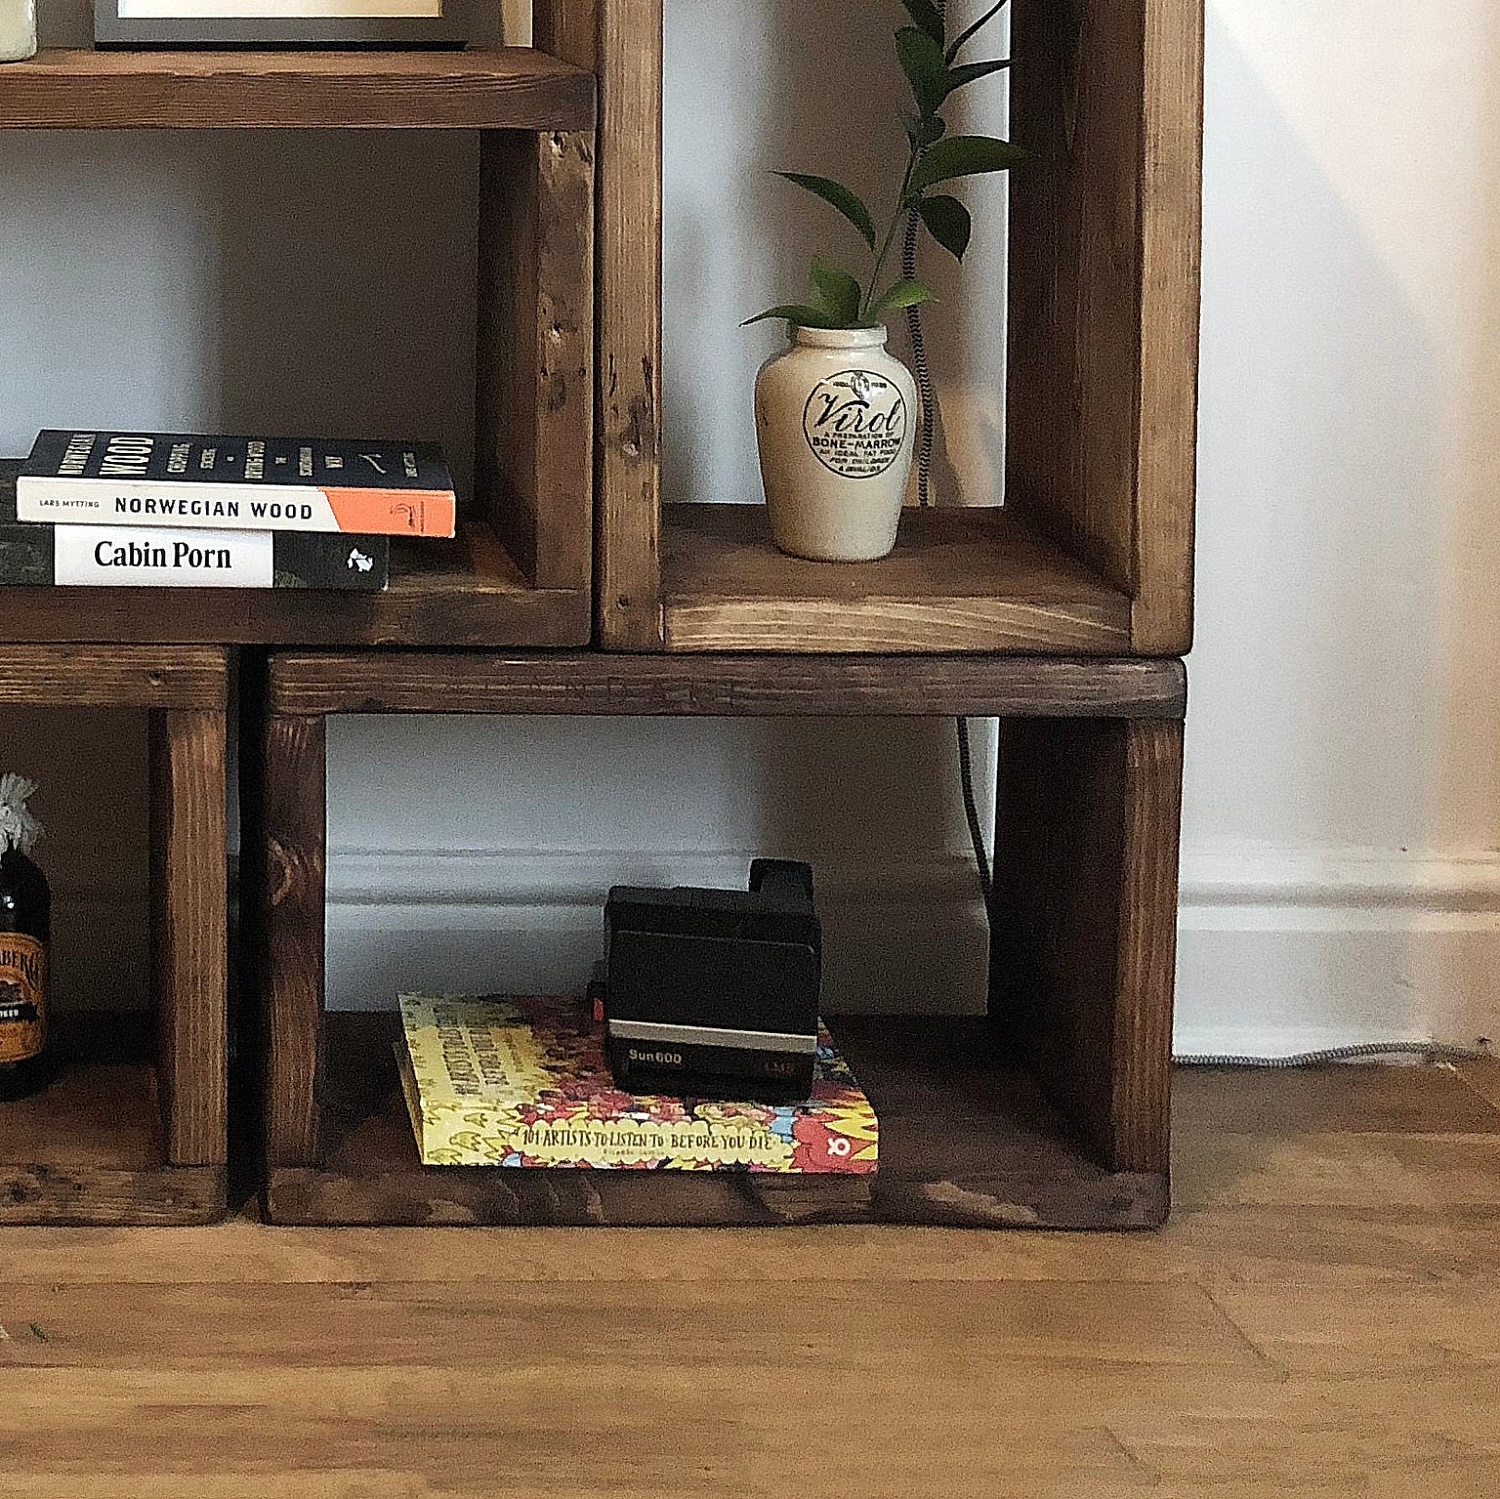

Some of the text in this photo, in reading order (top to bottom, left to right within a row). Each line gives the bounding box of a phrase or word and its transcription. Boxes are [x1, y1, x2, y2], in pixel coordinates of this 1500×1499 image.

[814, 393, 901, 432] Virol
[99, 437, 153, 475] WOOD
[39, 499, 60, 507] LARS
[115, 497, 239, 517] NORWEGIAN
[251, 502, 312, 519] WOOD
[94, 541, 232, 568] Cabin Porn
[523, 1129, 772, 1150] 101 ARTISTS TO LISTEN TO BEFORE YOU DIE
